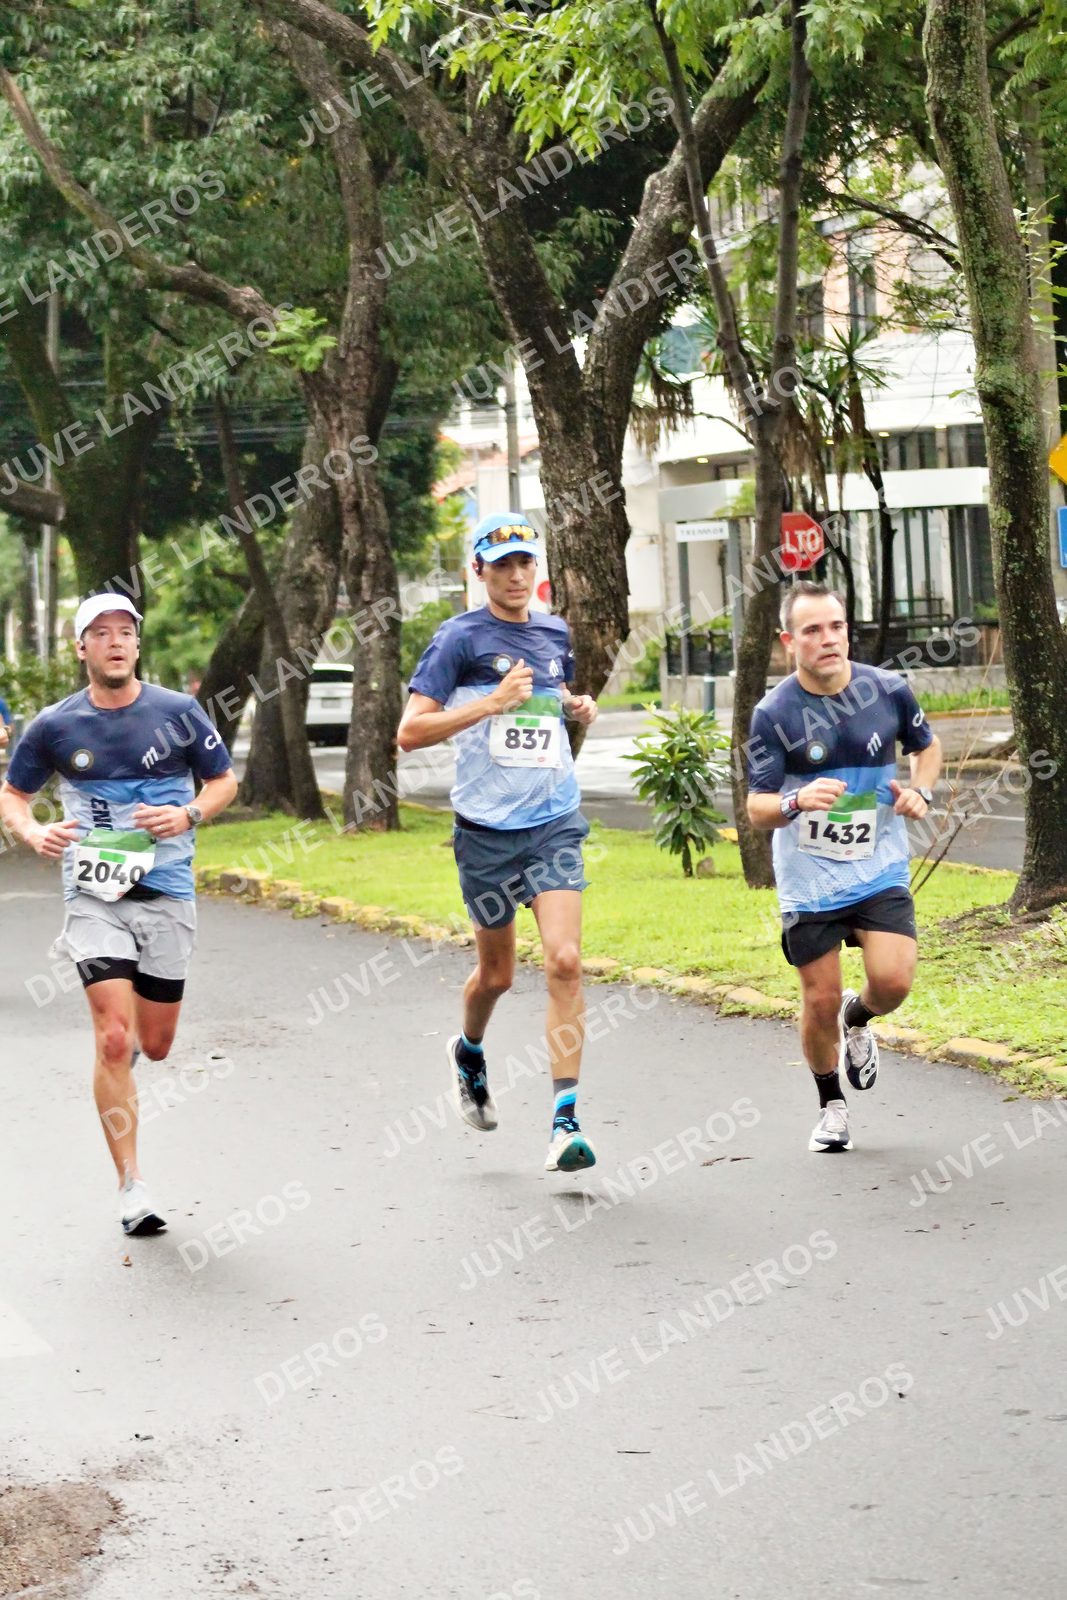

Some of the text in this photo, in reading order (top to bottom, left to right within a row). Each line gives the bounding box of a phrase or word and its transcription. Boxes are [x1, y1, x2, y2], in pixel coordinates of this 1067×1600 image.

[784, 528, 821, 553] LTO
[505, 728, 552, 750] 837
[808, 820, 871, 845] 1432
[78, 860, 146, 885] 2040
